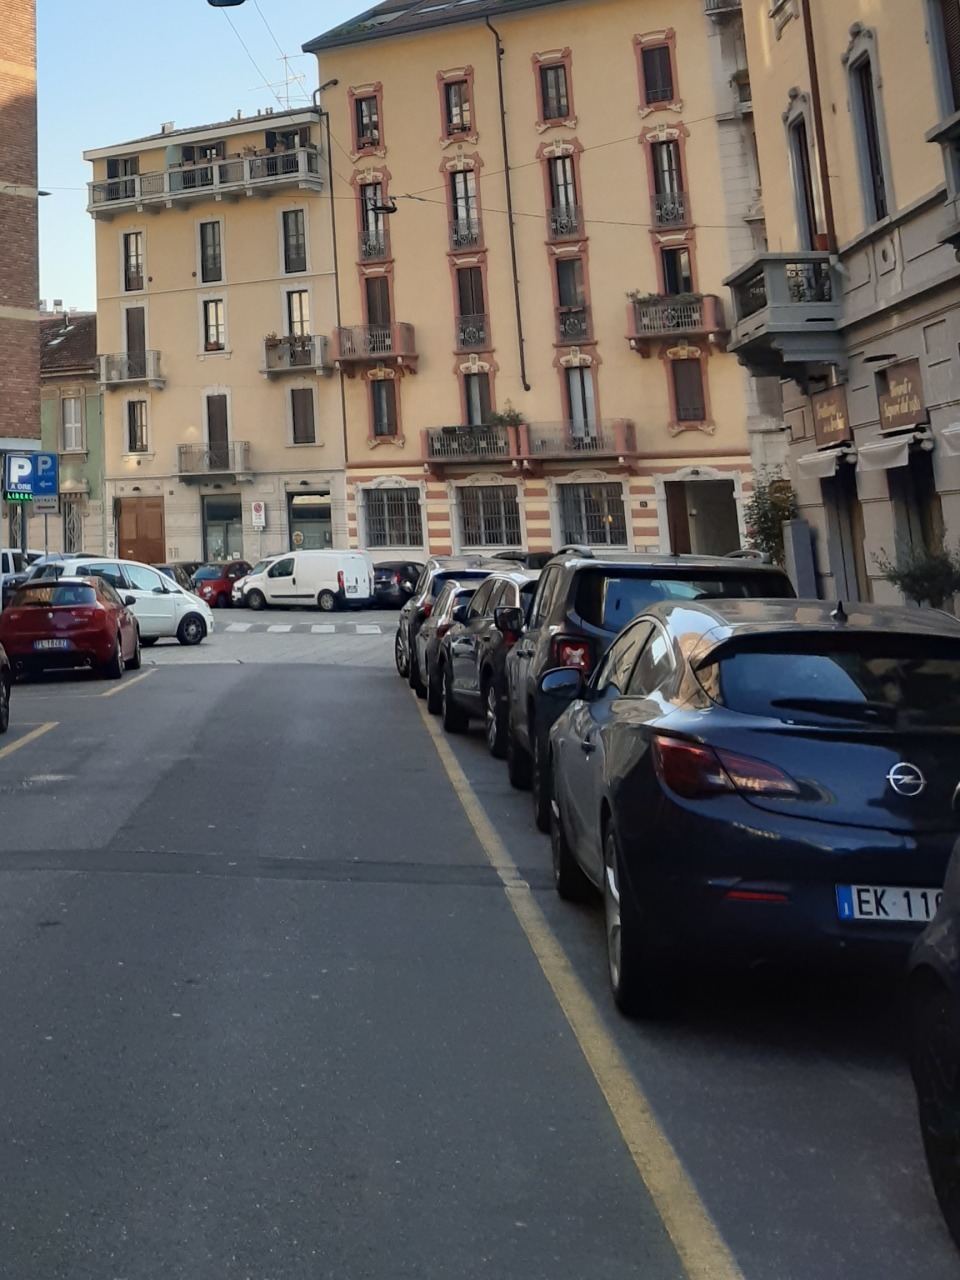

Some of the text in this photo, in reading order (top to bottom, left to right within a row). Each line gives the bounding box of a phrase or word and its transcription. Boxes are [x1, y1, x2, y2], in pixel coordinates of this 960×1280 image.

[10, 457, 32, 483] P
[37, 455, 52, 476] P
[856, 888, 890, 917] EK
